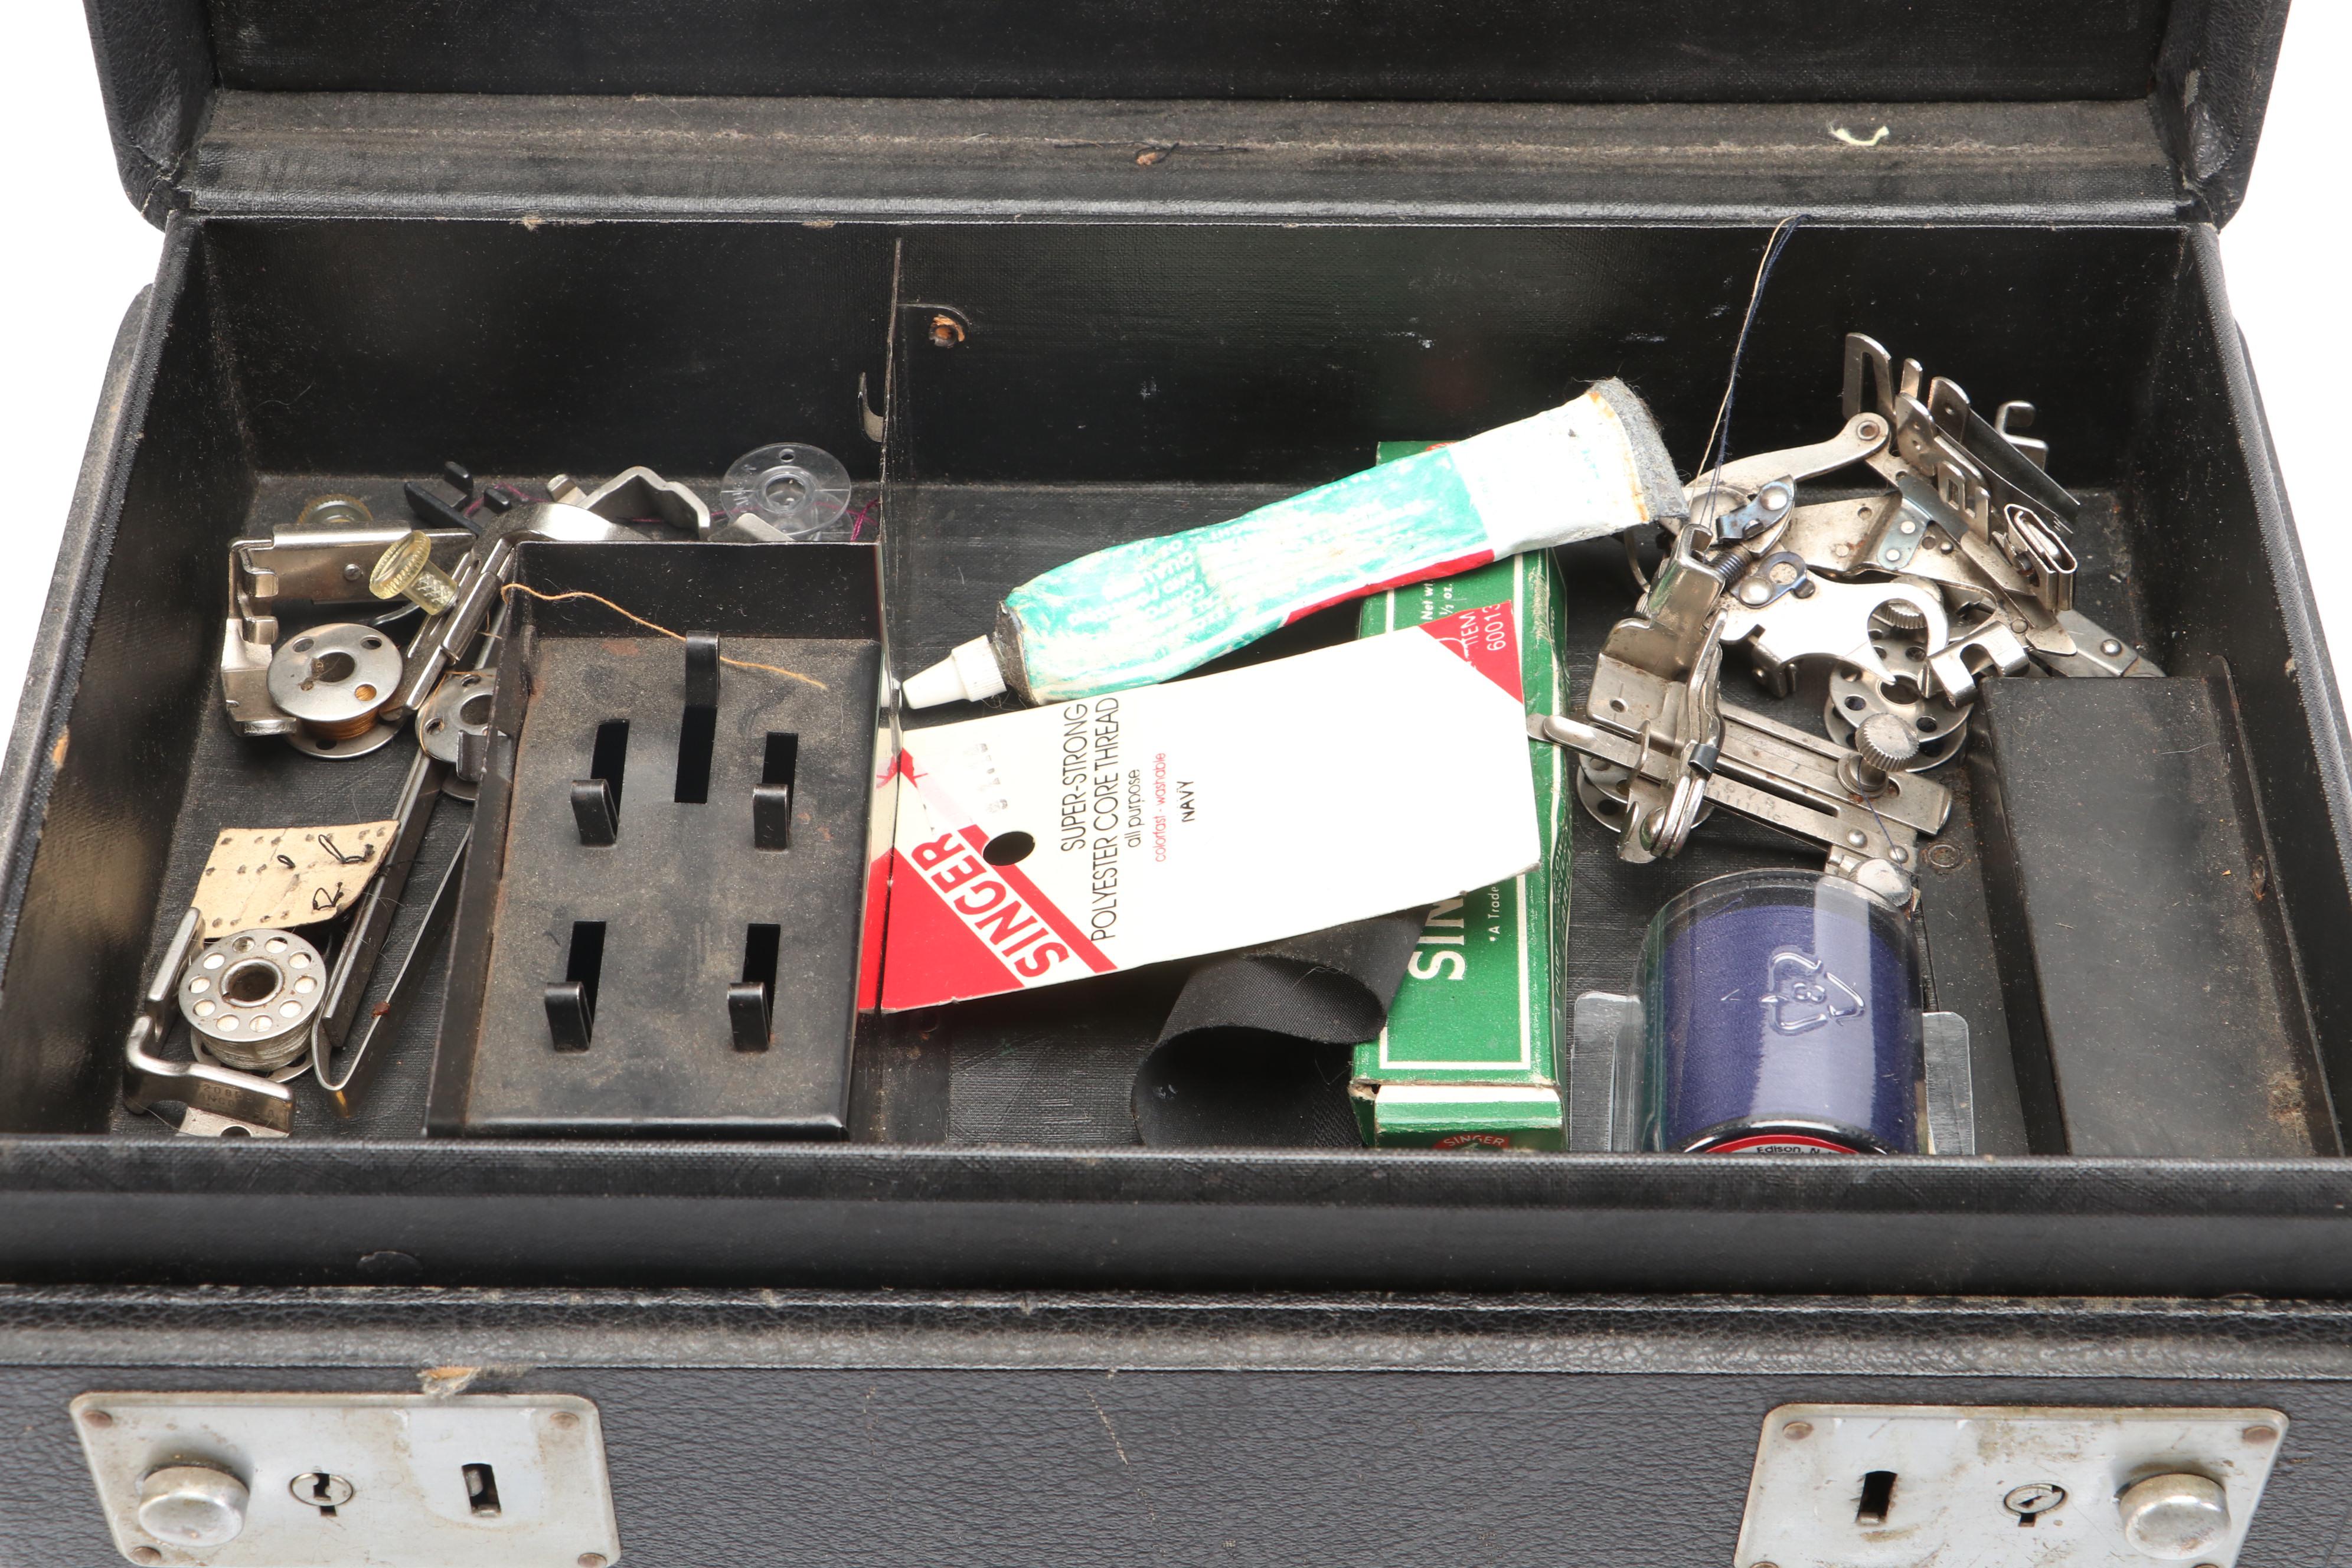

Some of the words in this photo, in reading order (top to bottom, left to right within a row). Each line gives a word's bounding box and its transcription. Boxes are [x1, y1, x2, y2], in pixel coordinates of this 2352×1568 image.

[1420, 600, 1433, 620] Net
[1095, 697, 1119, 771] THREAD
[1060, 704, 1088, 852] SUPER-STRONG
[1093, 772, 1118, 831] CORE
[1128, 769, 1145, 828] purpose
[1152, 752, 1167, 806] washable
[1177, 781, 1195, 823] NAVY
[1124, 831, 1141, 848] all
[1152, 815, 1167, 862] colorfast
[911, 832, 1070, 978] SINGER
[1091, 835, 1118, 942] POLYESTER
[1487, 886, 1500, 919] Trade
[1407, 897, 1466, 980] SIN
[1443, 1134, 1505, 1146] SINGER
